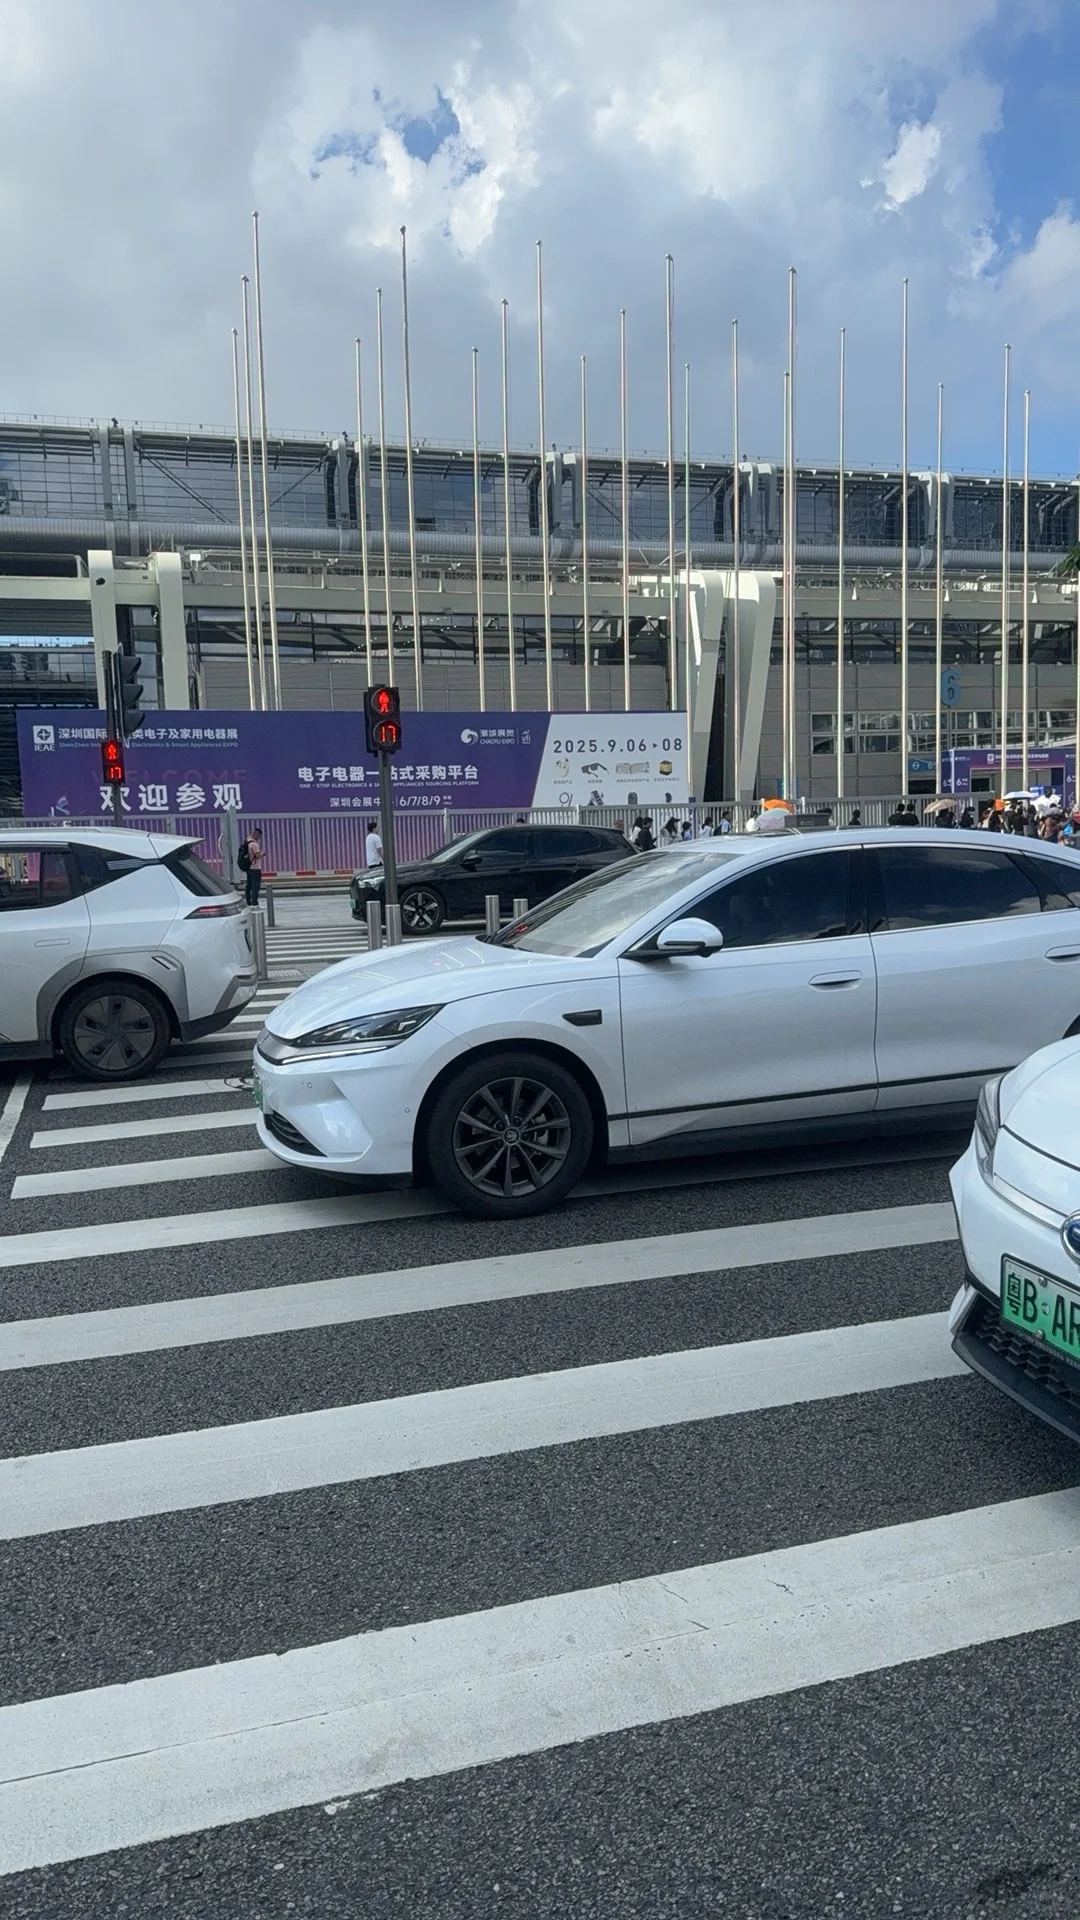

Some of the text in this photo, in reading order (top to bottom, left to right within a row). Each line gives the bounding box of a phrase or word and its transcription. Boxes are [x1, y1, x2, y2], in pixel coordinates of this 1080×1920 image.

[940, 667, 962, 708] 6
[58, 728, 239, 740] 深圳国际类电子及家用电器展
[382, 725, 396, 743] 17
[34, 744, 56, 752] IEAE
[553, 737, 683, 753] 2025.9.06 08
[110, 766, 122, 779] 17
[99, 782, 243, 812] 欢迎参观
[330, 796, 394, 807] 深圳会展中
[399, 795, 441, 807] 6/7/8/9
